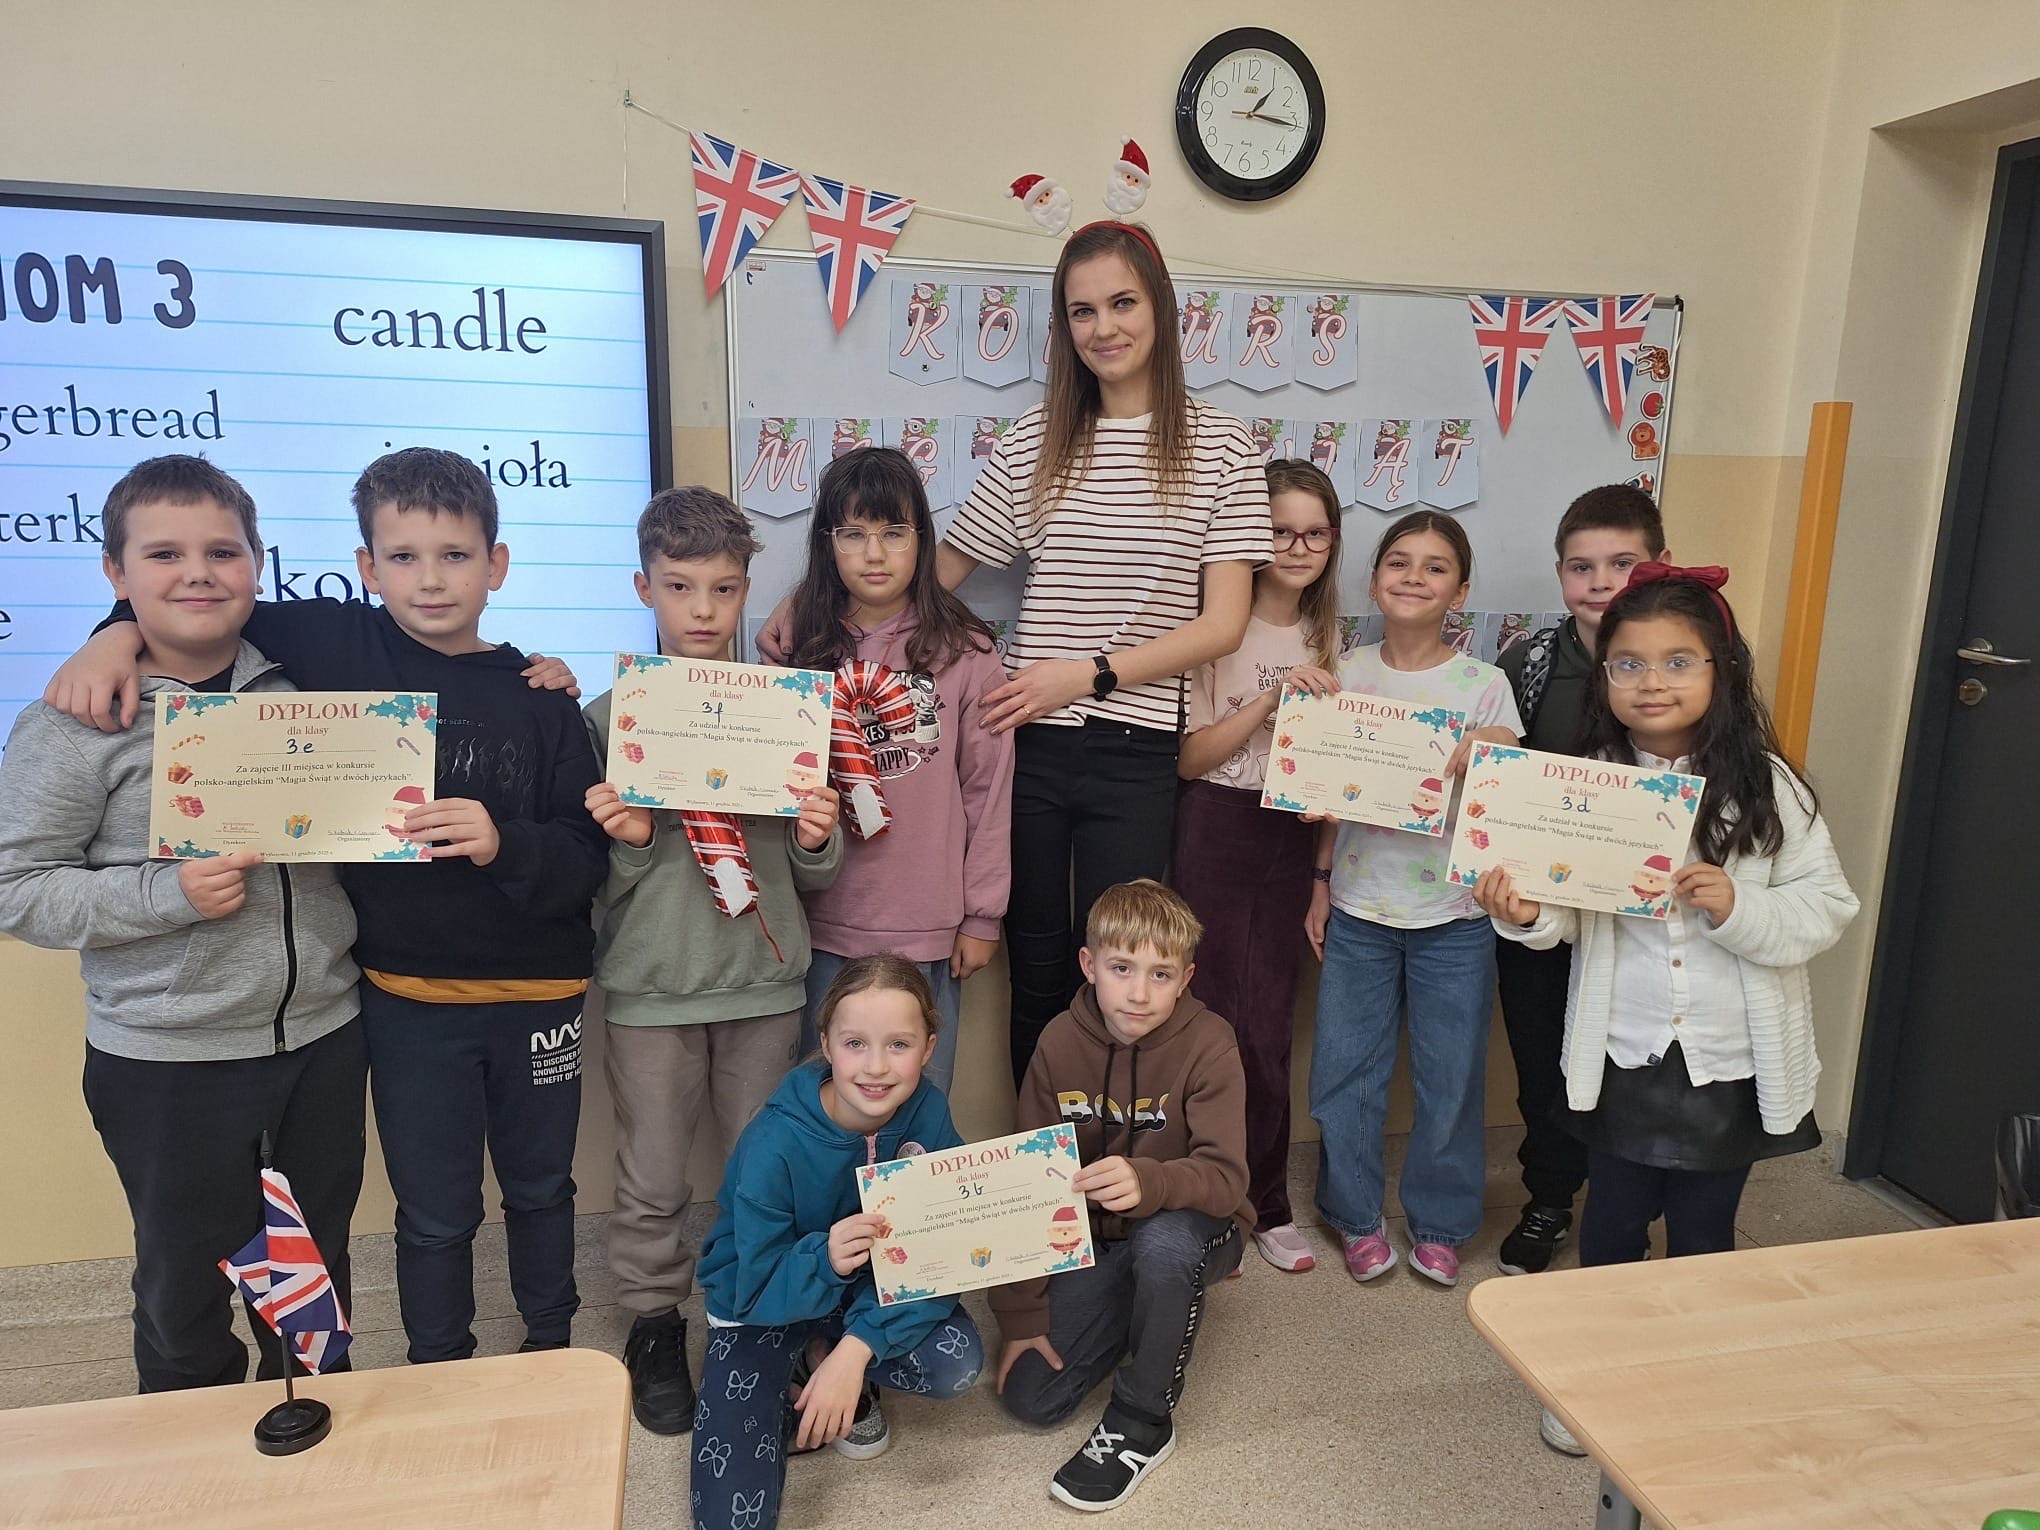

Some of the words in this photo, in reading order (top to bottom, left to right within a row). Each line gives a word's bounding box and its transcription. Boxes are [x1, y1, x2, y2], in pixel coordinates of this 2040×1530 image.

[1232, 62, 1241, 83] 11
[1248, 59, 1262, 81] 12
[1211, 76, 1228, 97] 10
[1282, 86, 1293, 108] 2
[1201, 101, 1213, 121] 9
[1288, 112, 1298, 132] 3
[1205, 126, 1217, 147] 8
[1276, 136, 1286, 155] 4
[1224, 144, 1233, 164] 7
[1238, 152, 1250, 172] 6
[1260, 150, 1270, 170] 5
[153, 259, 196, 329] 3
[333, 286, 548, 354] candle
[688, 668, 768, 689] DYPLOM
[709, 689, 722, 698] dla
[724, 690, 744, 701] klasy
[258, 703, 360, 721] DYPLOM
[1337, 699, 1406, 721] DYPLOM
[287, 726, 302, 735] dla
[305, 726, 329, 736] klasy
[730, 723, 761, 733] konkursie
[1354, 718, 1365, 726] dla
[1366, 719, 1382, 729] klasy
[637, 728, 698, 738] polsko-angielskim
[753, 737, 776, 745] dwóch
[863, 725, 885, 743] KES
[250, 765, 279, 774] zajęcie
[281, 764, 291, 772] III
[294, 763, 324, 772] miejsca
[336, 761, 375, 769] konkursie
[1543, 763, 1629, 789] DYPLOM
[194, 777, 274, 787] polsko-angielskim
[308, 774, 331, 783] Świąt
[342, 773, 370, 781] dwóch
[1563, 786, 1576, 795] dla
[1579, 788, 1599, 800] klasy
[1484, 817, 1546, 833] polsko-angielskim
[1580, 820, 1613, 832] konkursie
[532, 1060, 542, 1068] TO
[544, 1051, 577, 1067] DISCOVER
[533, 1060, 577, 1077] KNOWLEDGE
[533, 1074, 563, 1086] BENEFIT
[565, 1071, 574, 1081] OF
[930, 1146, 1011, 1176] DYPLOM
[956, 1175, 968, 1184] dla
[970, 1171, 990, 1181] klasy
[935, 1210, 958, 1220] zajęcie
[966, 1203, 991, 1213] miejsca
[1000, 1194, 1032, 1206] konkursie
[894, 1221, 955, 1239] polsko-angielskim
[981, 1210, 1000, 1220] Świąt
[1008, 1204, 1031, 1215] dwóch
